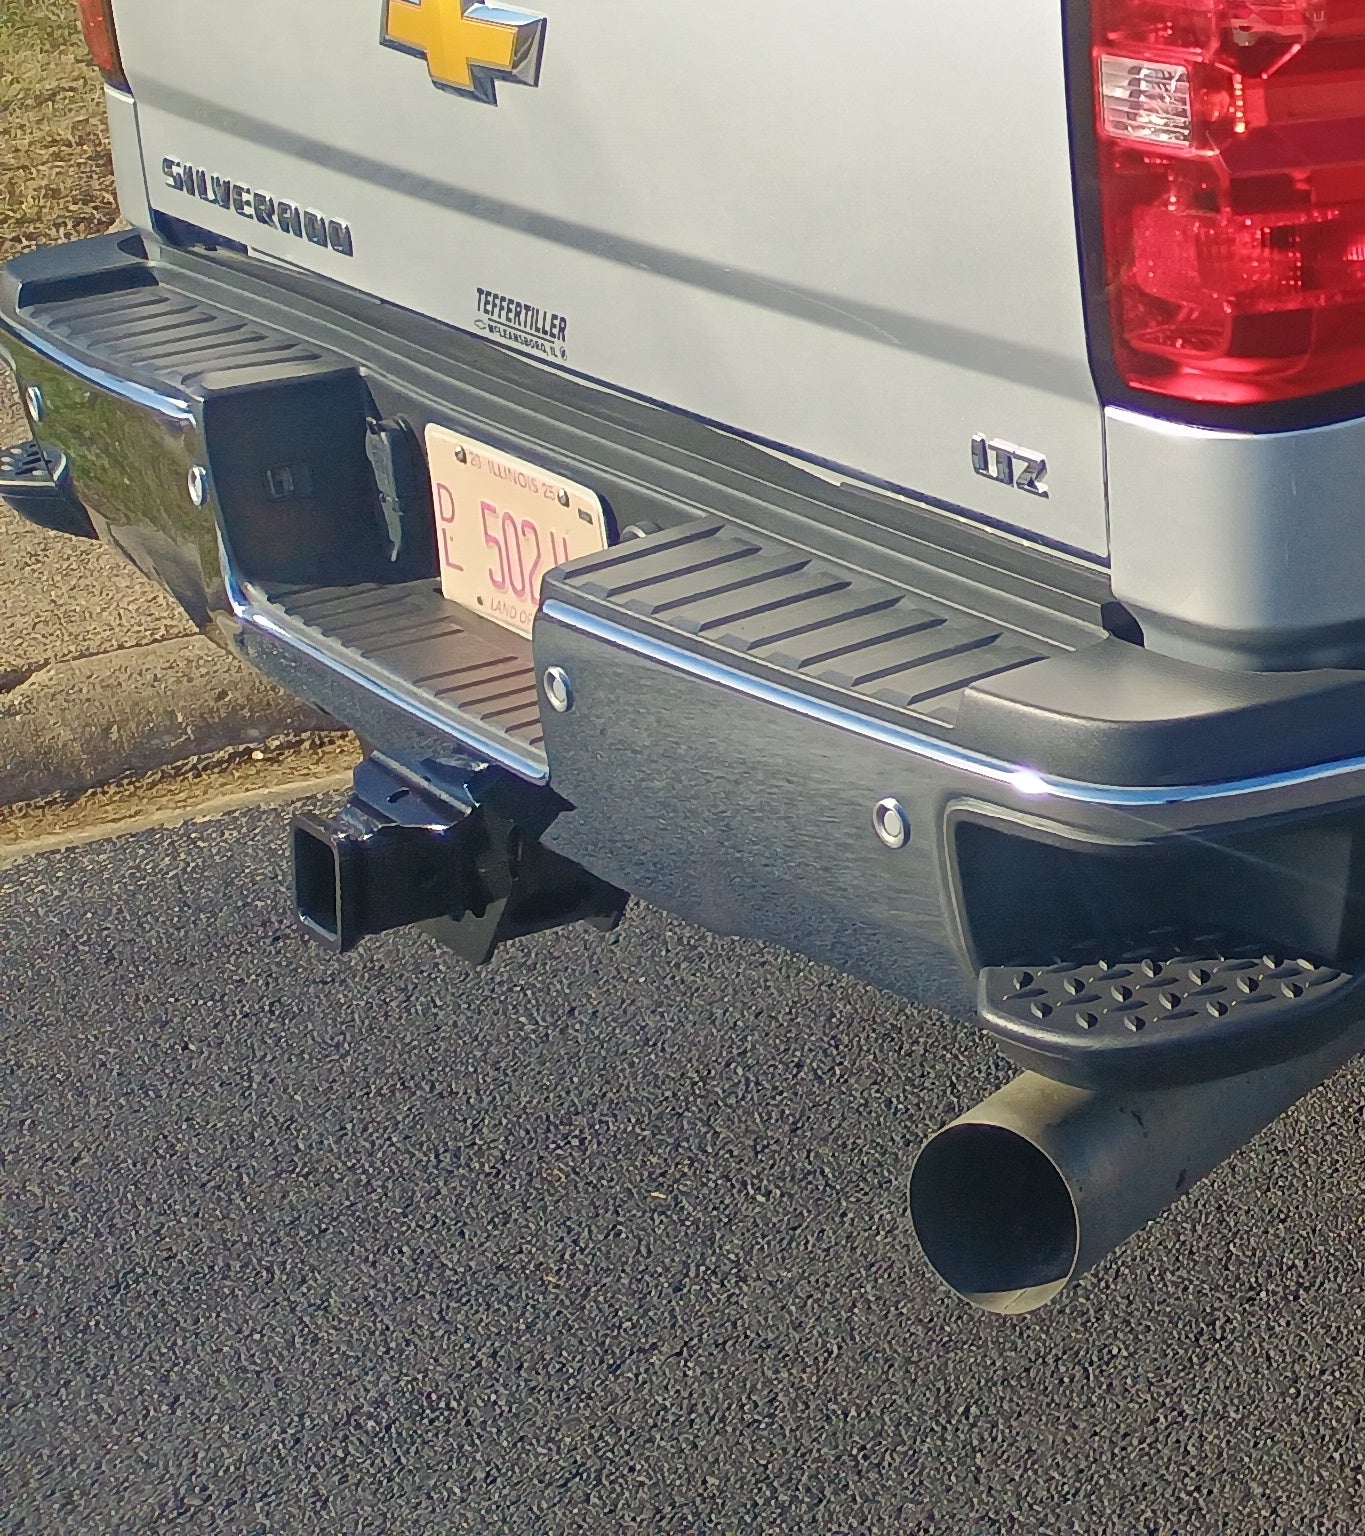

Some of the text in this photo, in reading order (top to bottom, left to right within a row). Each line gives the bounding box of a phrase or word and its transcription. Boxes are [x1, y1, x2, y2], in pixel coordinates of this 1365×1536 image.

[162, 154, 354, 258] SILVERADO
[476, 287, 567, 342] TEFFERTILLER
[487, 459, 539, 493] ILLINOIS
[971, 432, 1048, 499] LTZ
[490, 596, 517, 619] LAND
